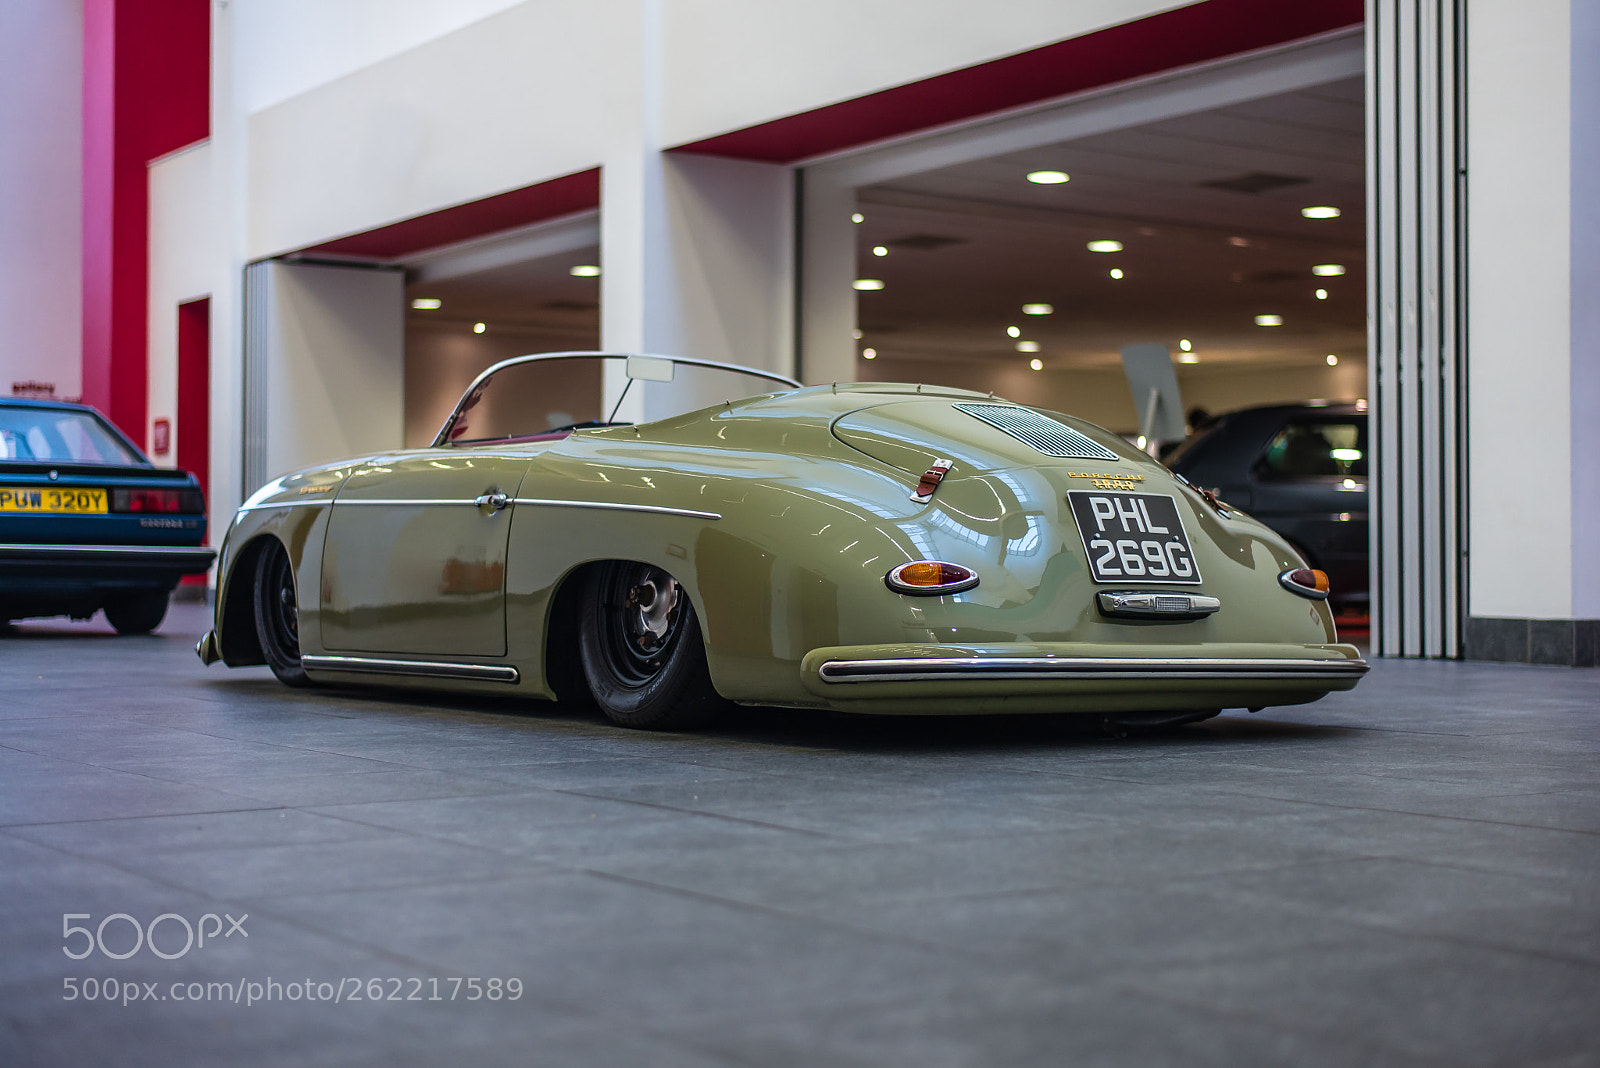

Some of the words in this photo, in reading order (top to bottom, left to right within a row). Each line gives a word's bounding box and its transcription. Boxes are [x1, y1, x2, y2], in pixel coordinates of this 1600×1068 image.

[1067, 471, 1146, 480] PORSCHE
[50, 492, 101, 511] 320Y
[1089, 497, 1169, 534] PHL
[1090, 539, 1193, 577] 269G
